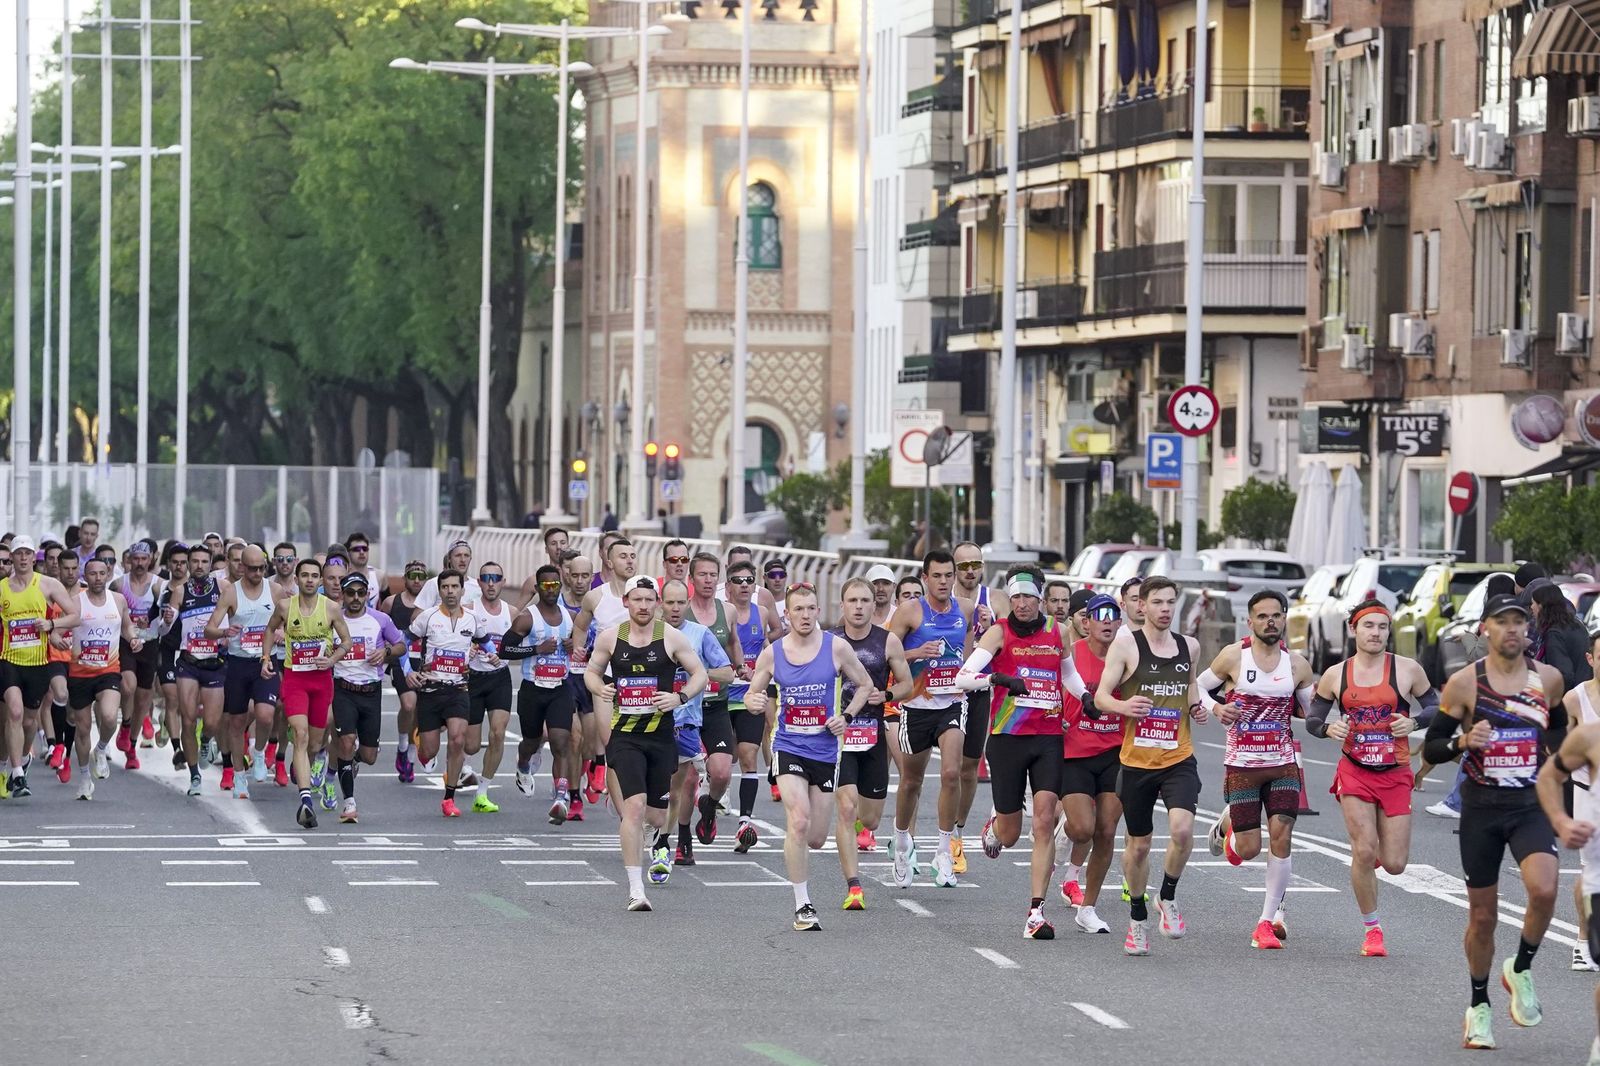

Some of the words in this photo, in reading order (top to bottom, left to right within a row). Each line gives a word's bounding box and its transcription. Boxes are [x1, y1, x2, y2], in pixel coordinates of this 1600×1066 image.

[1381, 416, 1439, 432] TINTE
[1395, 431, 1432, 457] 5€
[1151, 438, 1174, 468] P
[12, 633, 38, 641] MICHAEL
[88, 627, 112, 638] AQA
[81, 653, 107, 661] JEFFREY
[1031, 669, 1053, 678] ZURICH
[784, 682, 828, 693] TOTTON
[1153, 709, 1177, 717] ZURICH
[792, 716, 819, 725] SHAUN
[1140, 728, 1174, 740] FLORIAN
[1366, 733, 1390, 741] ZURICH
[1501, 730, 1532, 739] ZURICH
[845, 736, 869, 745] AITOR
[1236, 744, 1266, 752] JOAQUIN
[1361, 753, 1383, 763] JOAN
[1483, 755, 1525, 766] ATIENZA
